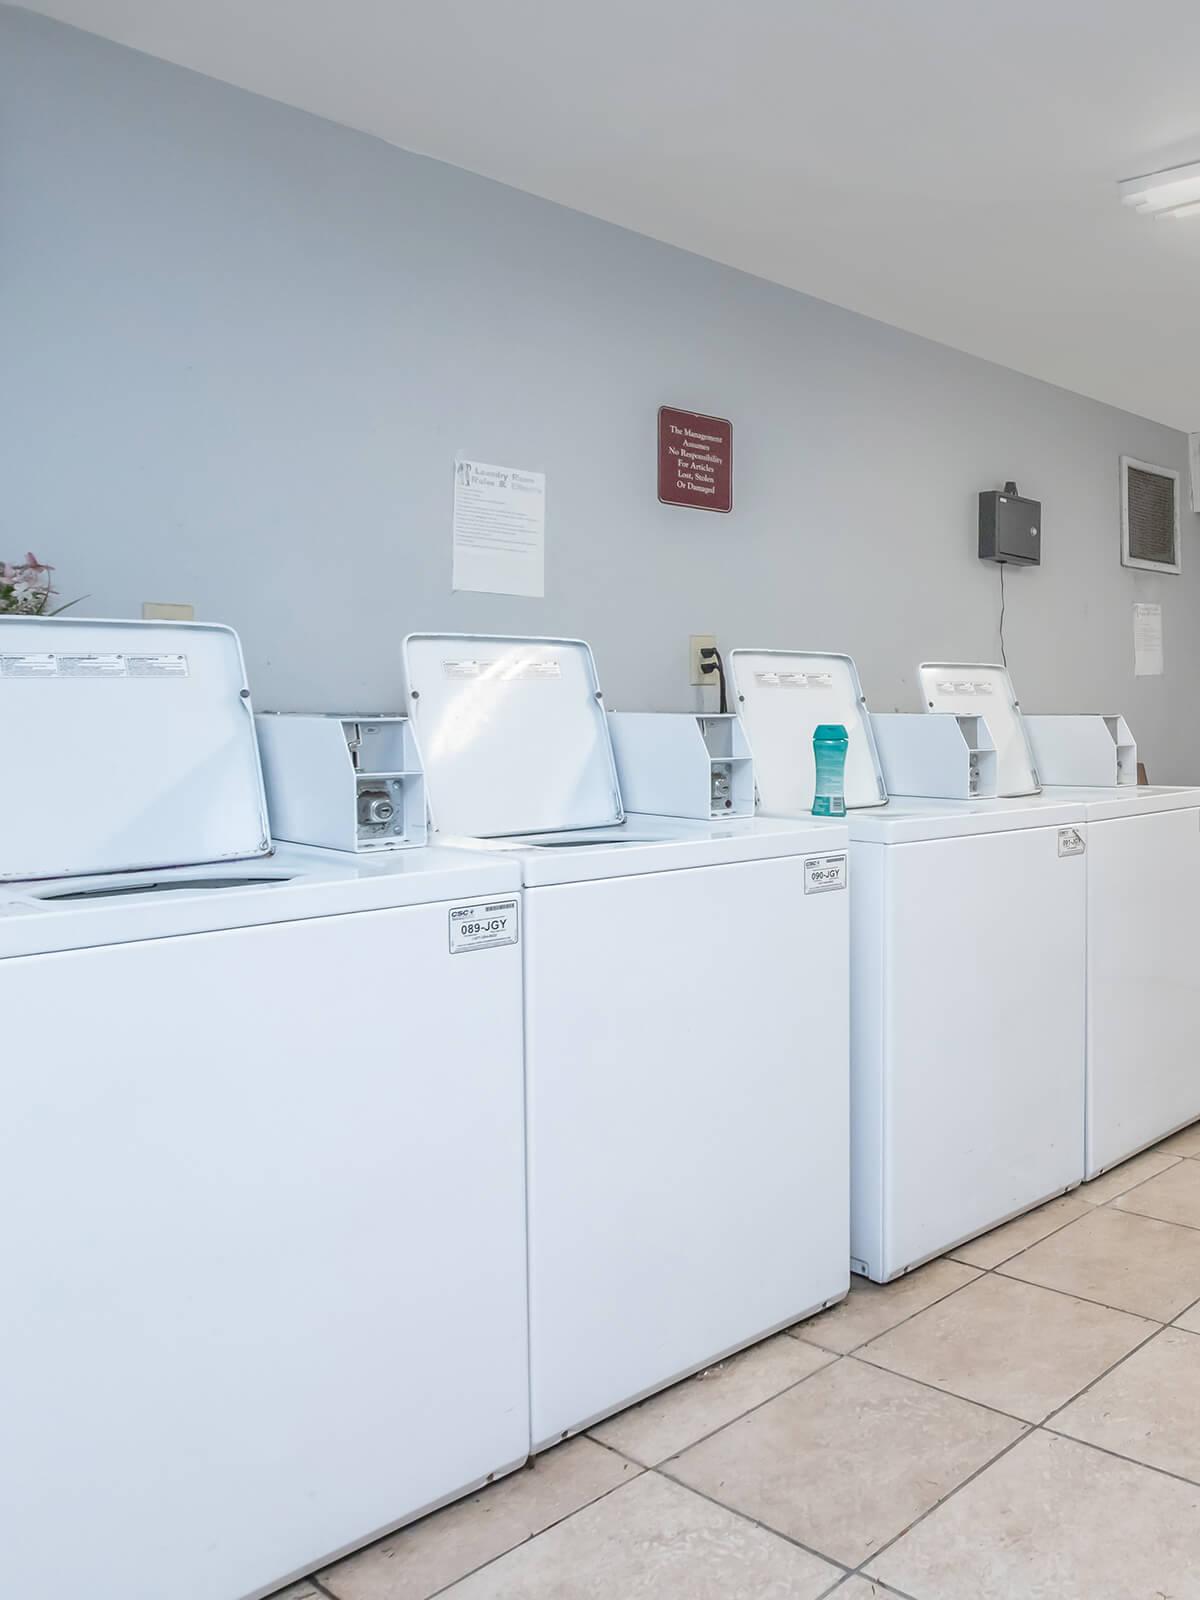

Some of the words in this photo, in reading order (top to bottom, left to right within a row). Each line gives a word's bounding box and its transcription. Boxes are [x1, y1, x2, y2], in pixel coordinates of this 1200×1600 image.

[669, 424, 683, 436] The
[684, 428, 723, 444] Management
[668, 446, 680, 456] No
[681, 449, 723, 465] Responsibility
[475, 466, 508, 481] Laundry
[677, 459, 689, 469] For
[691, 462, 715, 473] Articles
[677, 469, 694, 480] Lost,
[694, 473, 715, 484] Stolen
[676, 480, 686, 489] Or
[687, 482, 715, 495] Damaged
[811, 869, 840, 881] 090-JGY
[451, 909, 469, 918] CSC
[461, 919, 507, 935] 089-JGY
